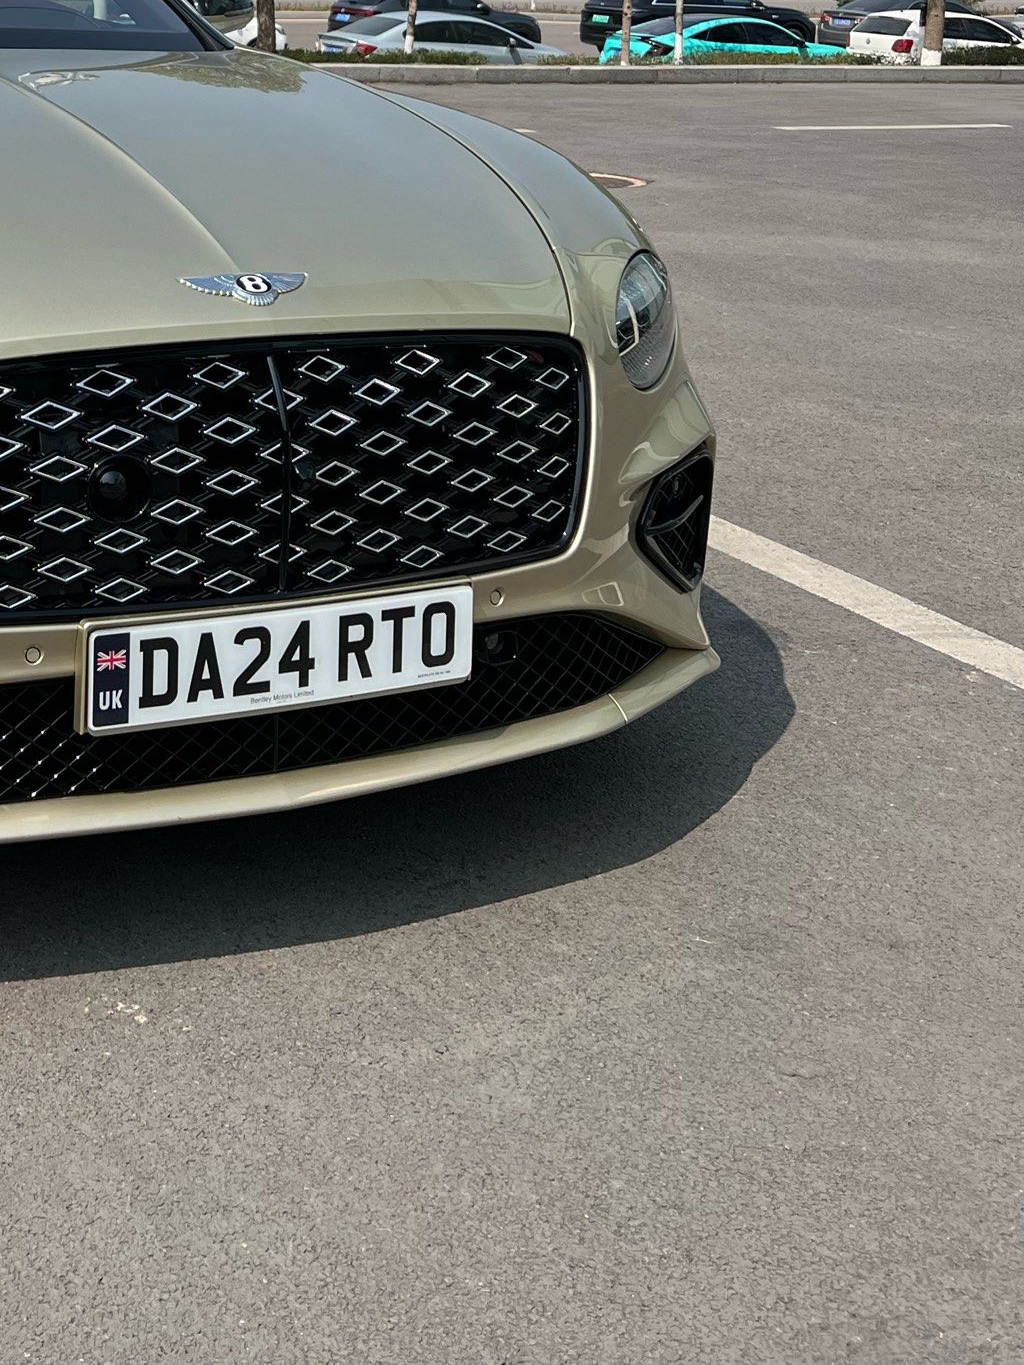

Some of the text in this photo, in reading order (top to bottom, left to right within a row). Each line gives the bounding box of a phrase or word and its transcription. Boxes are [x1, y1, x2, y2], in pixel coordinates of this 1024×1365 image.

[139, 600, 456, 709] DA24 RTO
[98, 689, 123, 711] UK
[250, 695, 272, 705] Bentley
[272, 692, 293, 701] Motors
